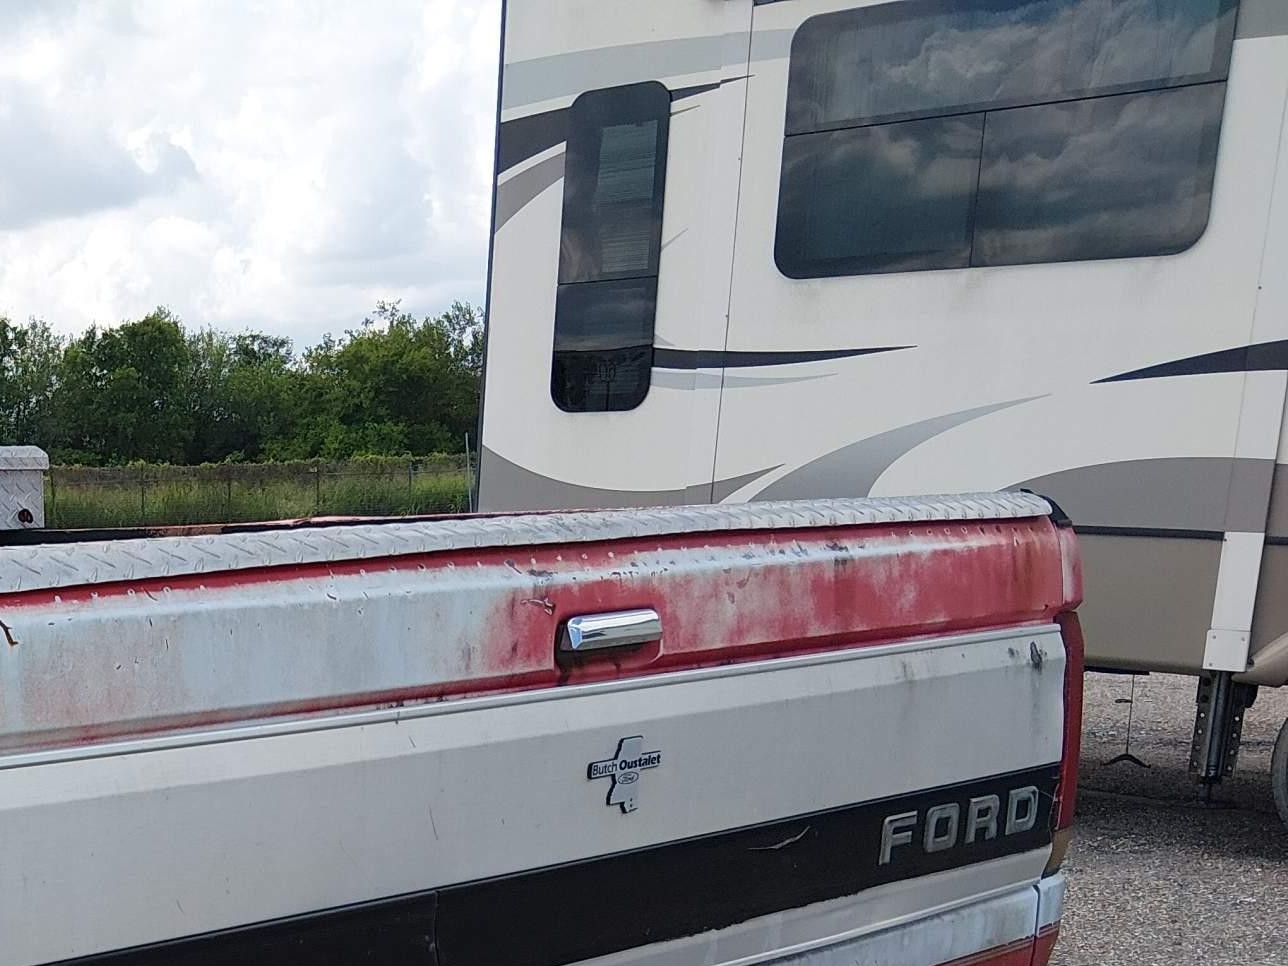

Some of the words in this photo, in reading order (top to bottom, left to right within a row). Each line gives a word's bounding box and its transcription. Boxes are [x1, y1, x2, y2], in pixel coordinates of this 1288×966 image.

[592, 762, 617, 776] Butch
[619, 754, 661, 770] Oustalet
[878, 785, 1040, 866] FORD
